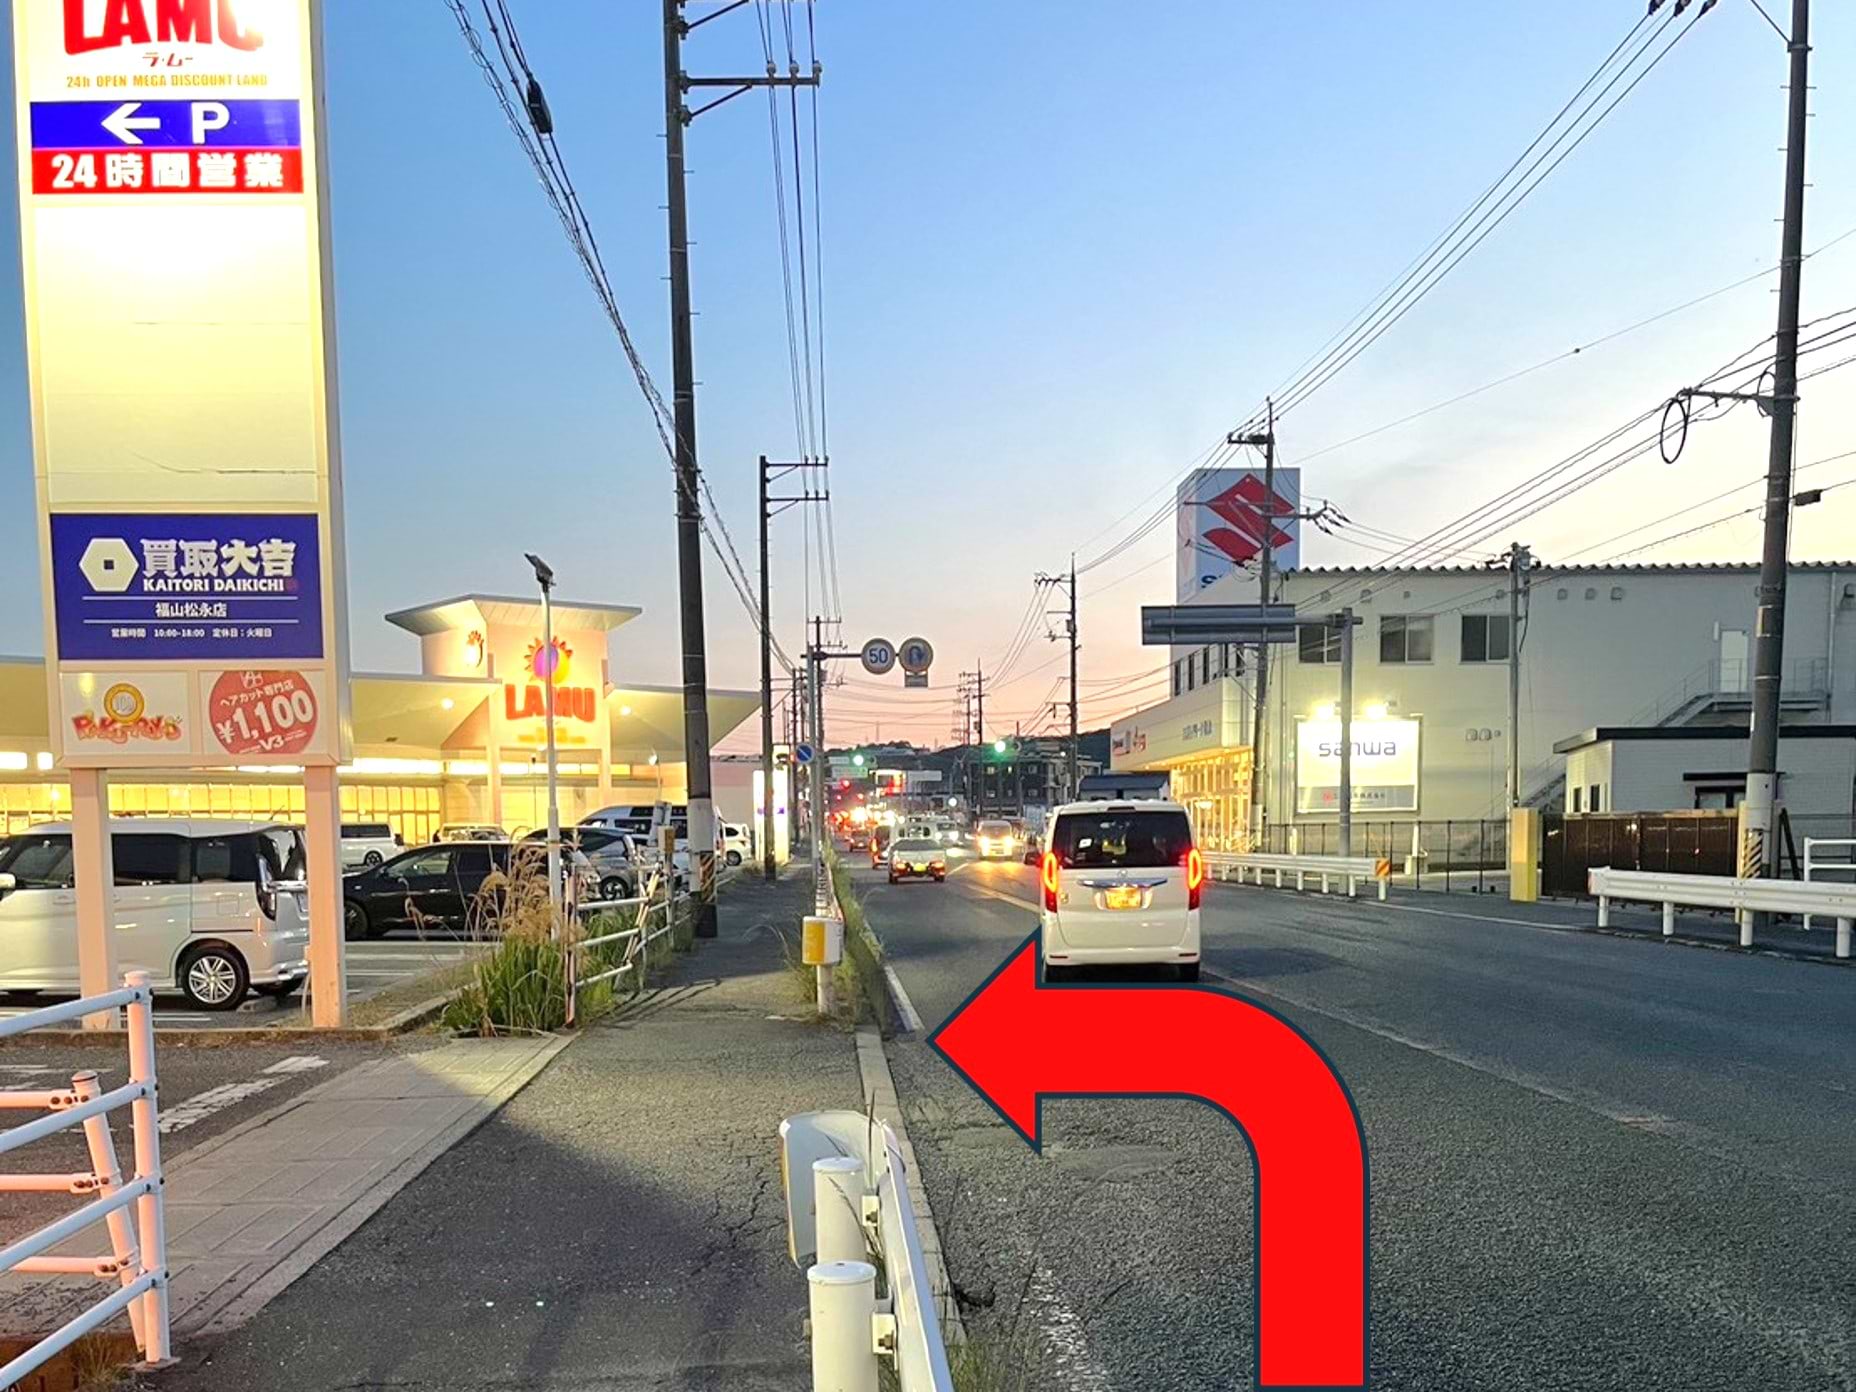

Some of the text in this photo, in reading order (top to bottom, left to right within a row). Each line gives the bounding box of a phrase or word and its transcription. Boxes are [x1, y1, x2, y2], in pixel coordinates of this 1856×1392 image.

[66, 74, 268, 88] 24h OPEN MEGA DISCOUNT LAND
[191, 101, 230, 144] P
[51, 152, 284, 189] 24時間営業
[140, 538, 297, 578] 買取大吉
[143, 579, 284, 592] KAITORI DAIKICHI
[155, 602, 227, 618] 福山松永店
[868, 647, 889, 664] 50
[216, 690, 315, 744] ¥1,100
[505, 684, 596, 723] LAMU
[1319, 741, 1397, 758] sanwa
